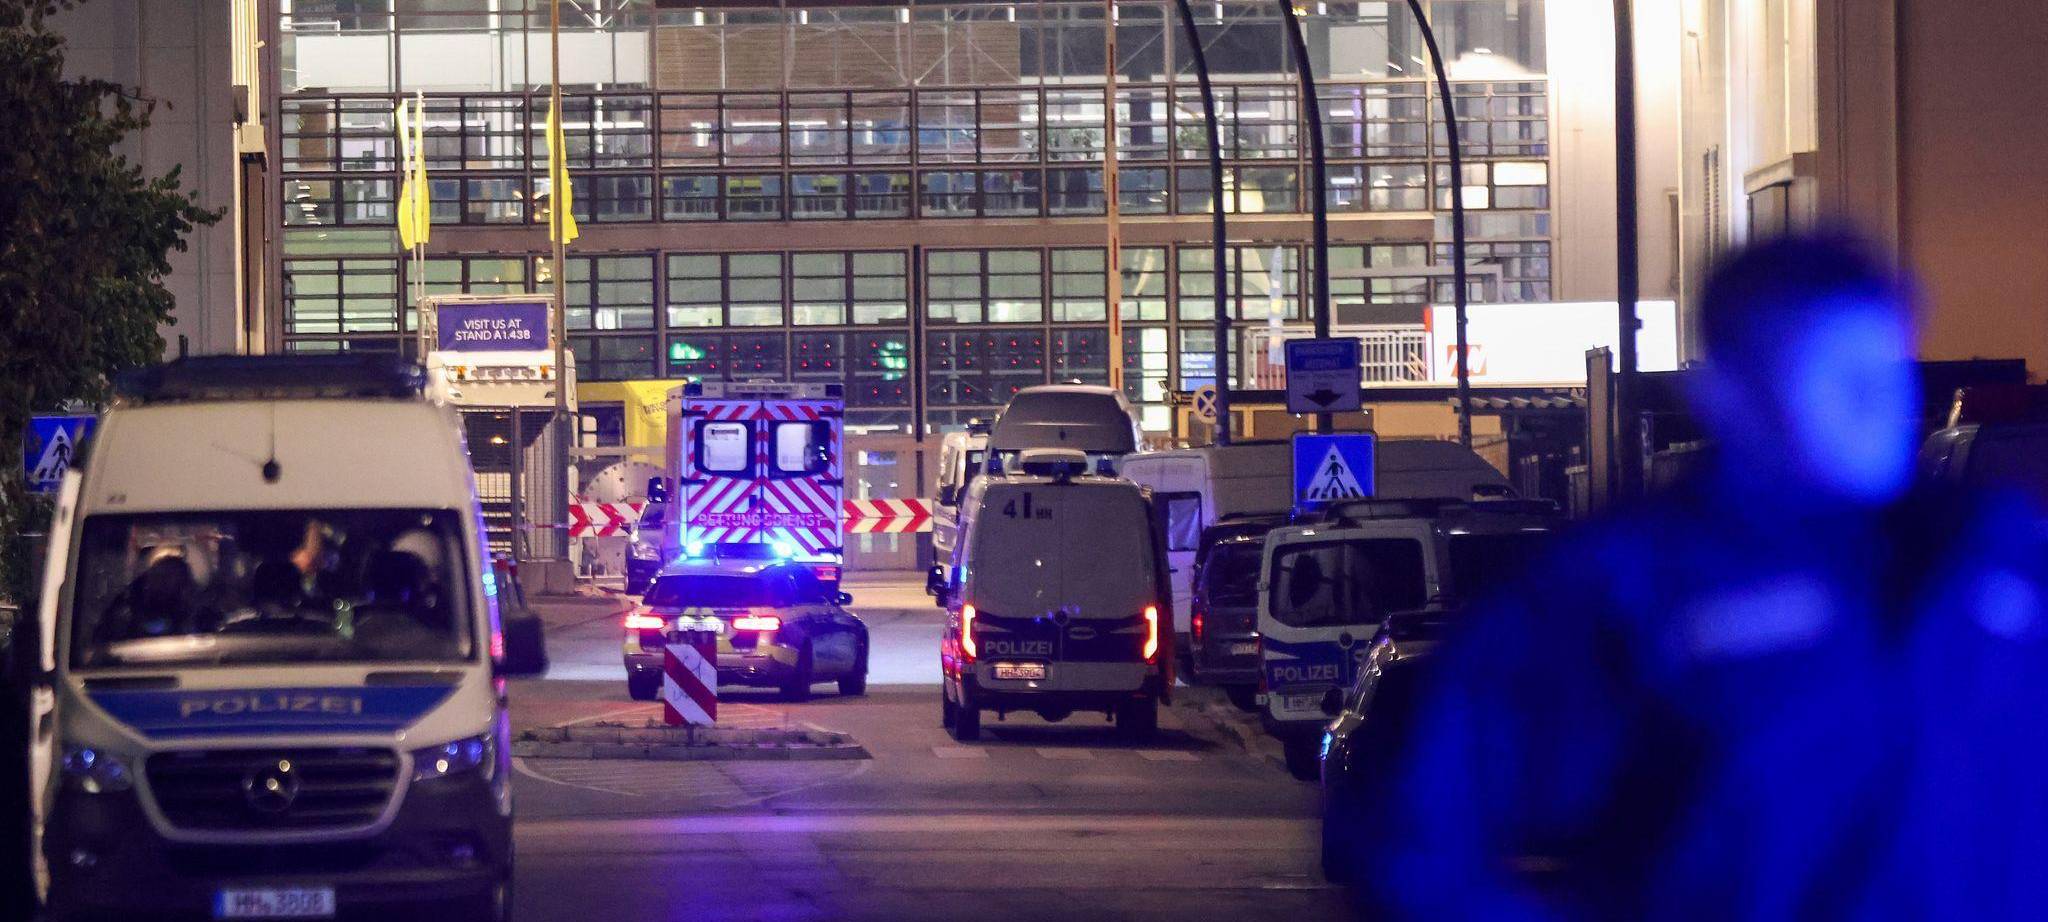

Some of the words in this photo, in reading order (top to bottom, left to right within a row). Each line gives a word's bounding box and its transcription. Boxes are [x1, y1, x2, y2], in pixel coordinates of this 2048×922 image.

[464, 320, 490, 329] VISIT
[492, 320, 507, 329] US
[508, 319, 522, 328] AT
[455, 331, 492, 341] STAND
[494, 330, 531, 340] A1.438
[984, 640, 1053, 655] POLIZEI
[1273, 664, 1339, 681] POLIZEI
[180, 696, 363, 717] POLIZEI
